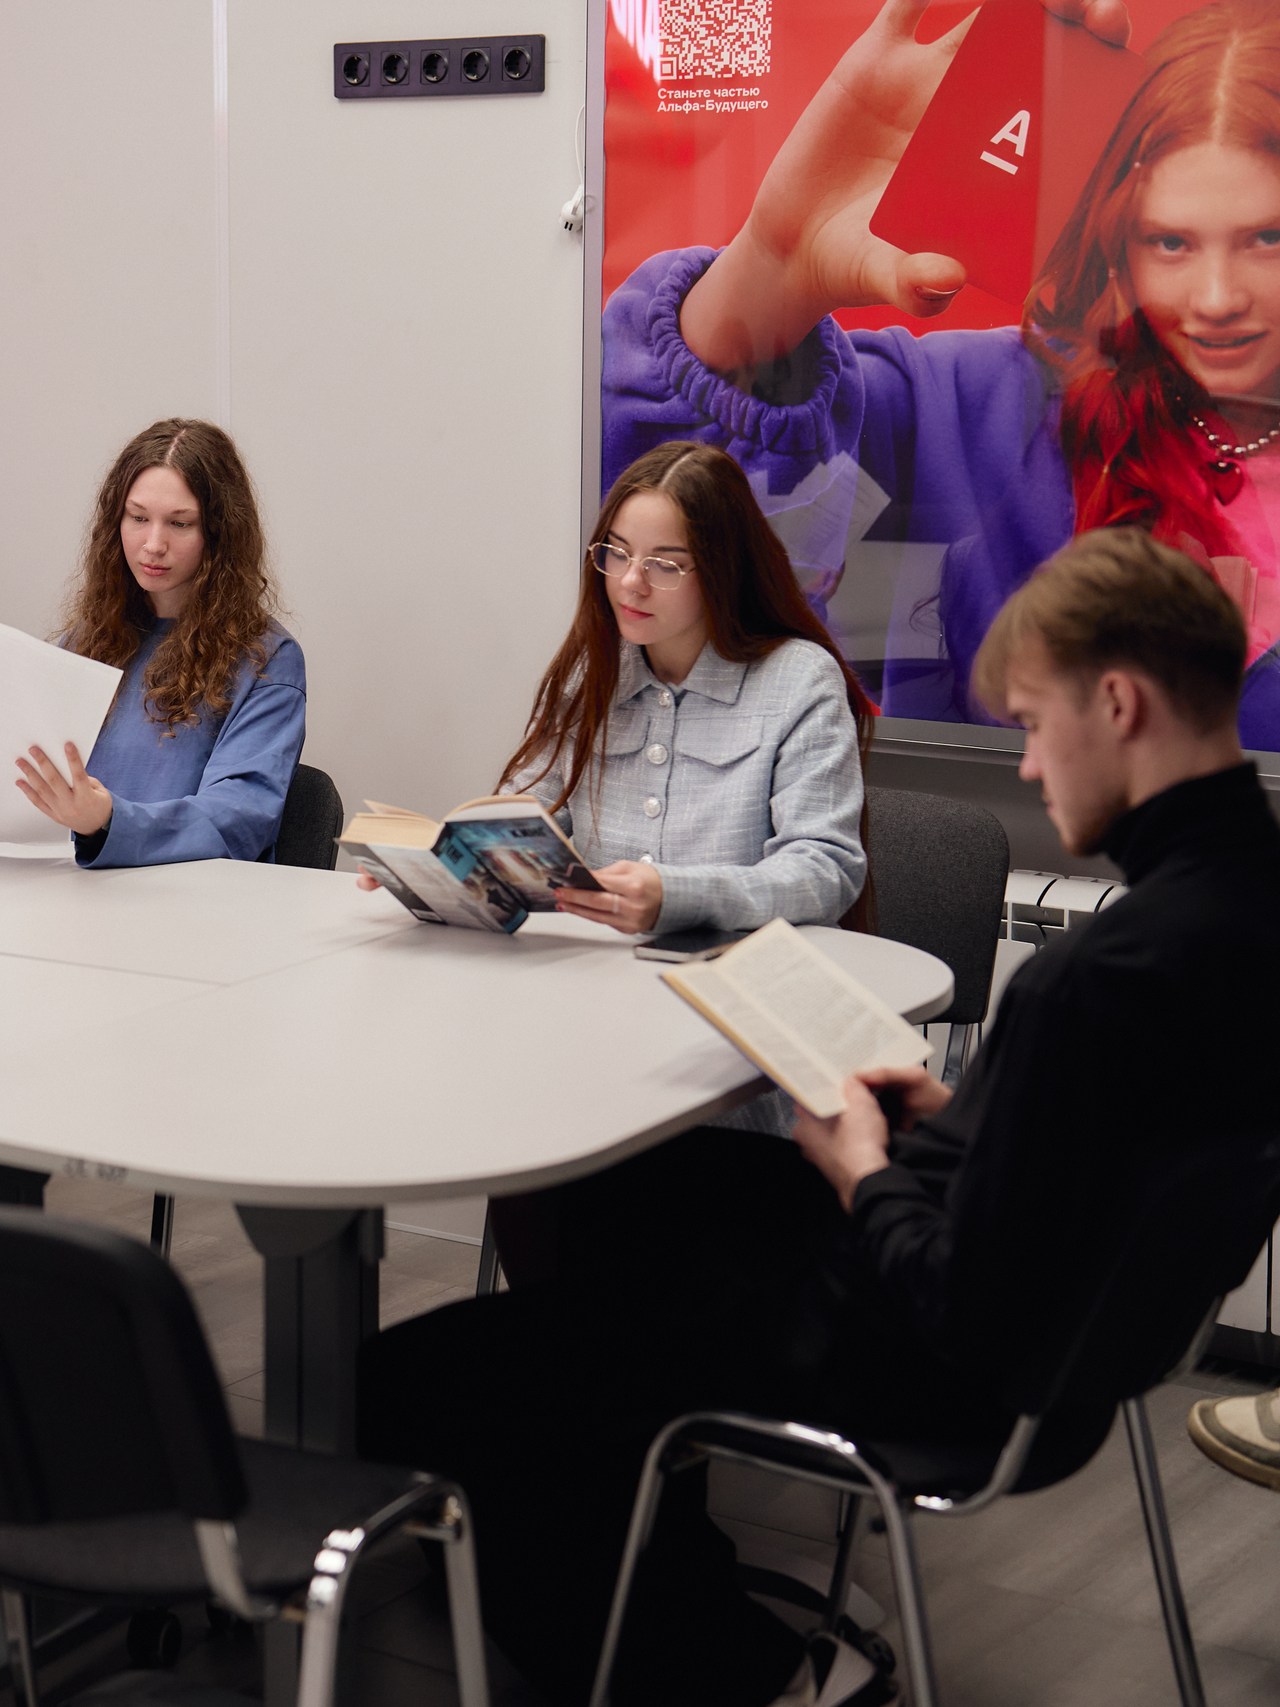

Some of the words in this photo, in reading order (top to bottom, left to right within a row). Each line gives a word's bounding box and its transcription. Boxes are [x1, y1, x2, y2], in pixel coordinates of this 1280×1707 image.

[657, 88, 711, 99] Станьте
[713, 87, 760, 98] частью
[657, 100, 769, 114] Альфа-Будущего
